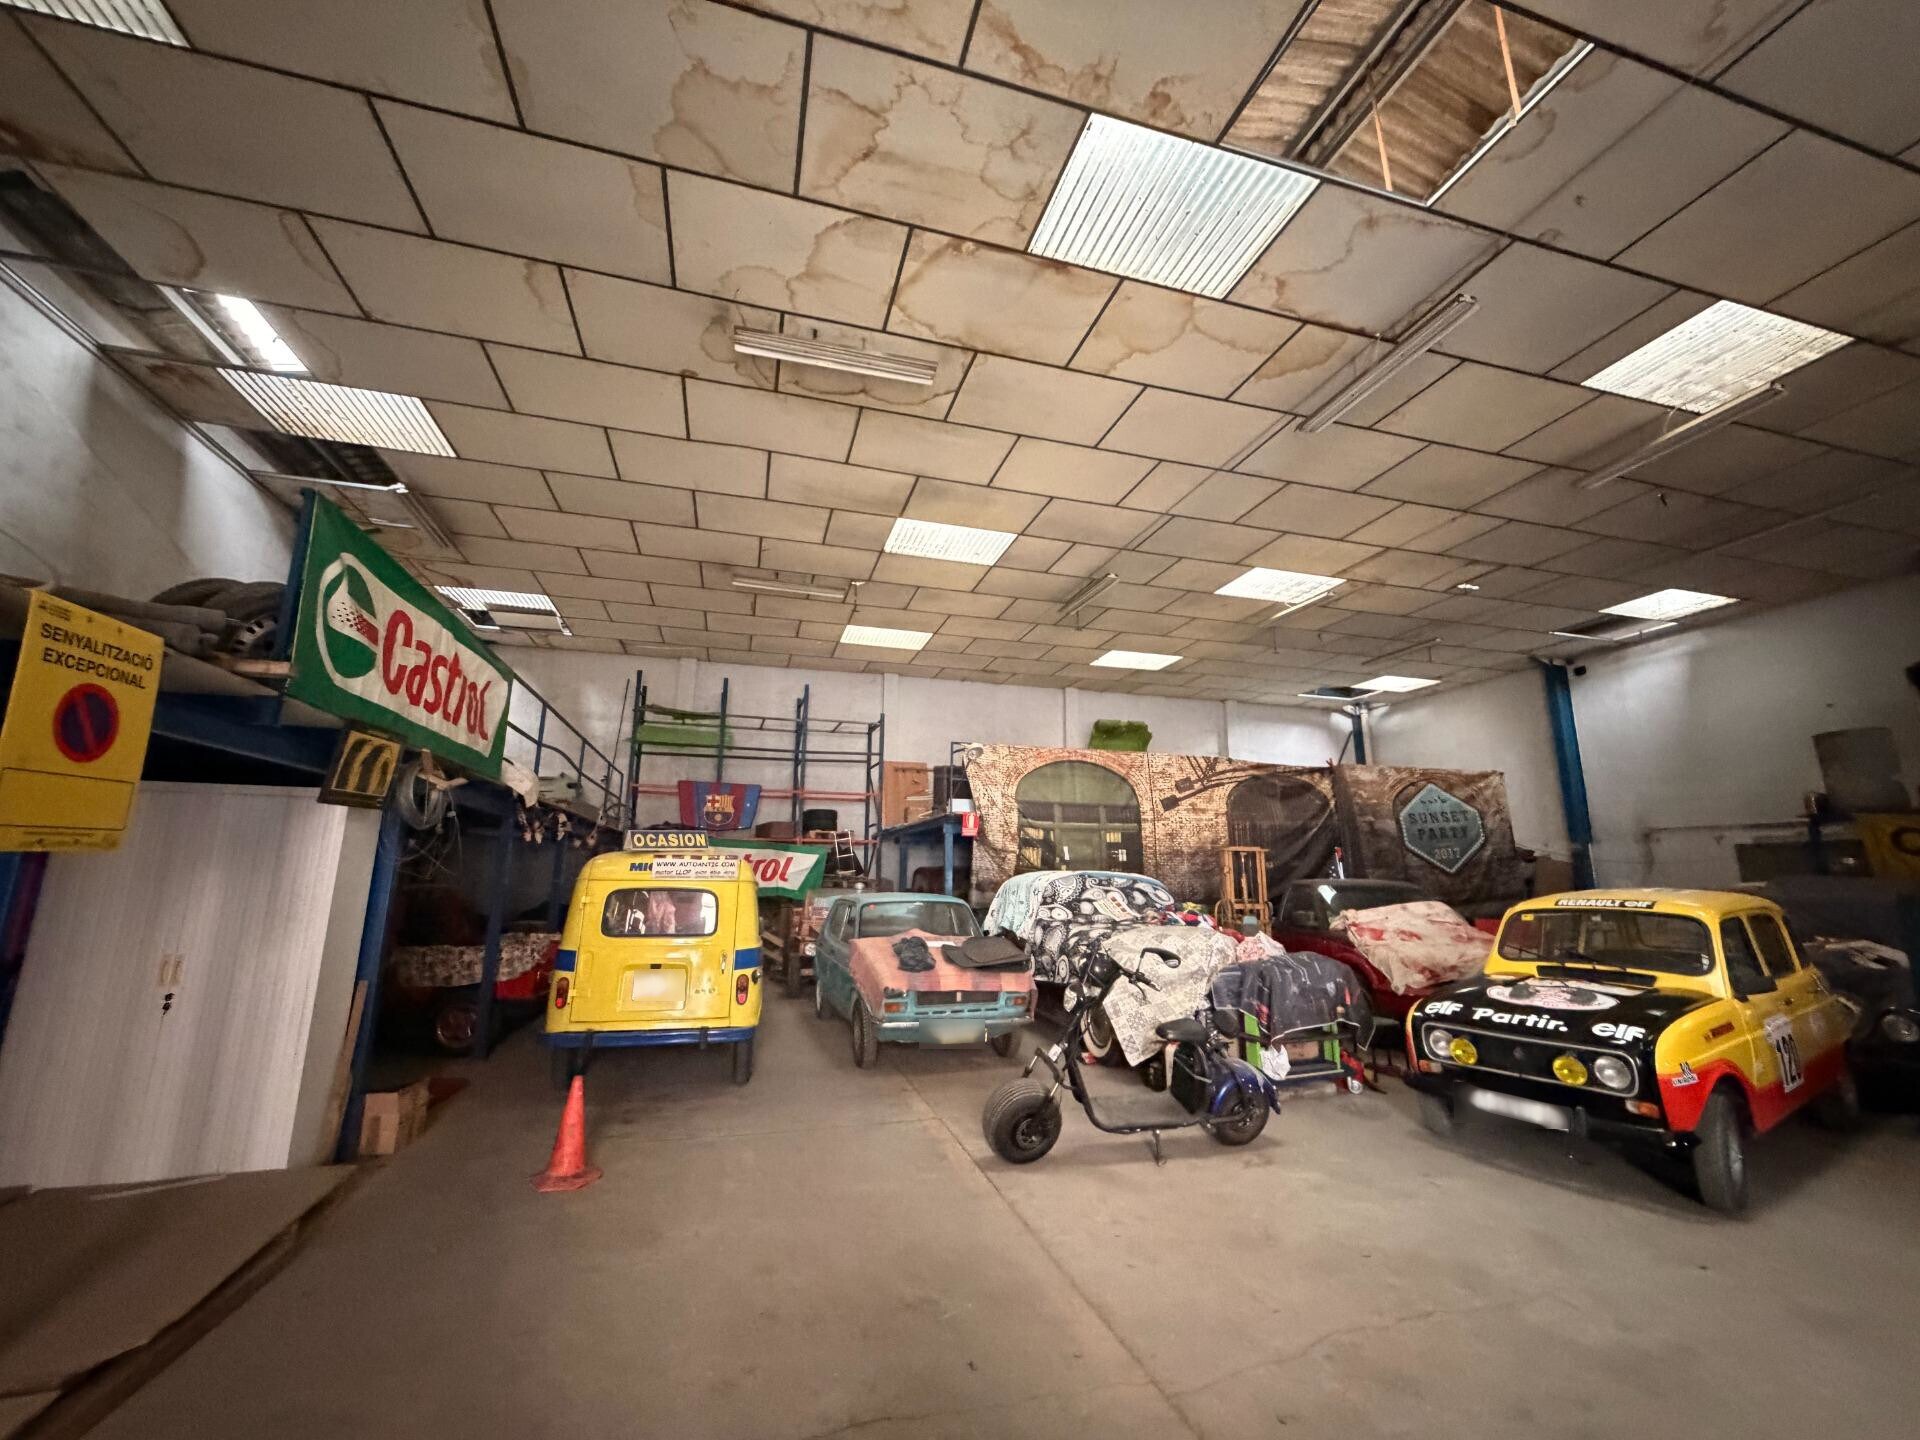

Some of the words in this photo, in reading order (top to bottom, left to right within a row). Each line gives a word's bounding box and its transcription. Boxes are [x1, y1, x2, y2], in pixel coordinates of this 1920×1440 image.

[41, 622, 153, 671] SENYALITZACIÓ
[42, 647, 146, 689] EXCEPCIONAL
[383, 609, 492, 741] Castrol
[1408, 811, 1469, 824] SUNSET
[633, 833, 706, 847] OCASION
[1417, 826, 1468, 840] PARTY
[1557, 899, 1623, 907] RENAULT
[1425, 1001, 1464, 1015] elf
[1472, 1007, 1568, 1032] Partir.
[1591, 1022, 1646, 1042] elf
